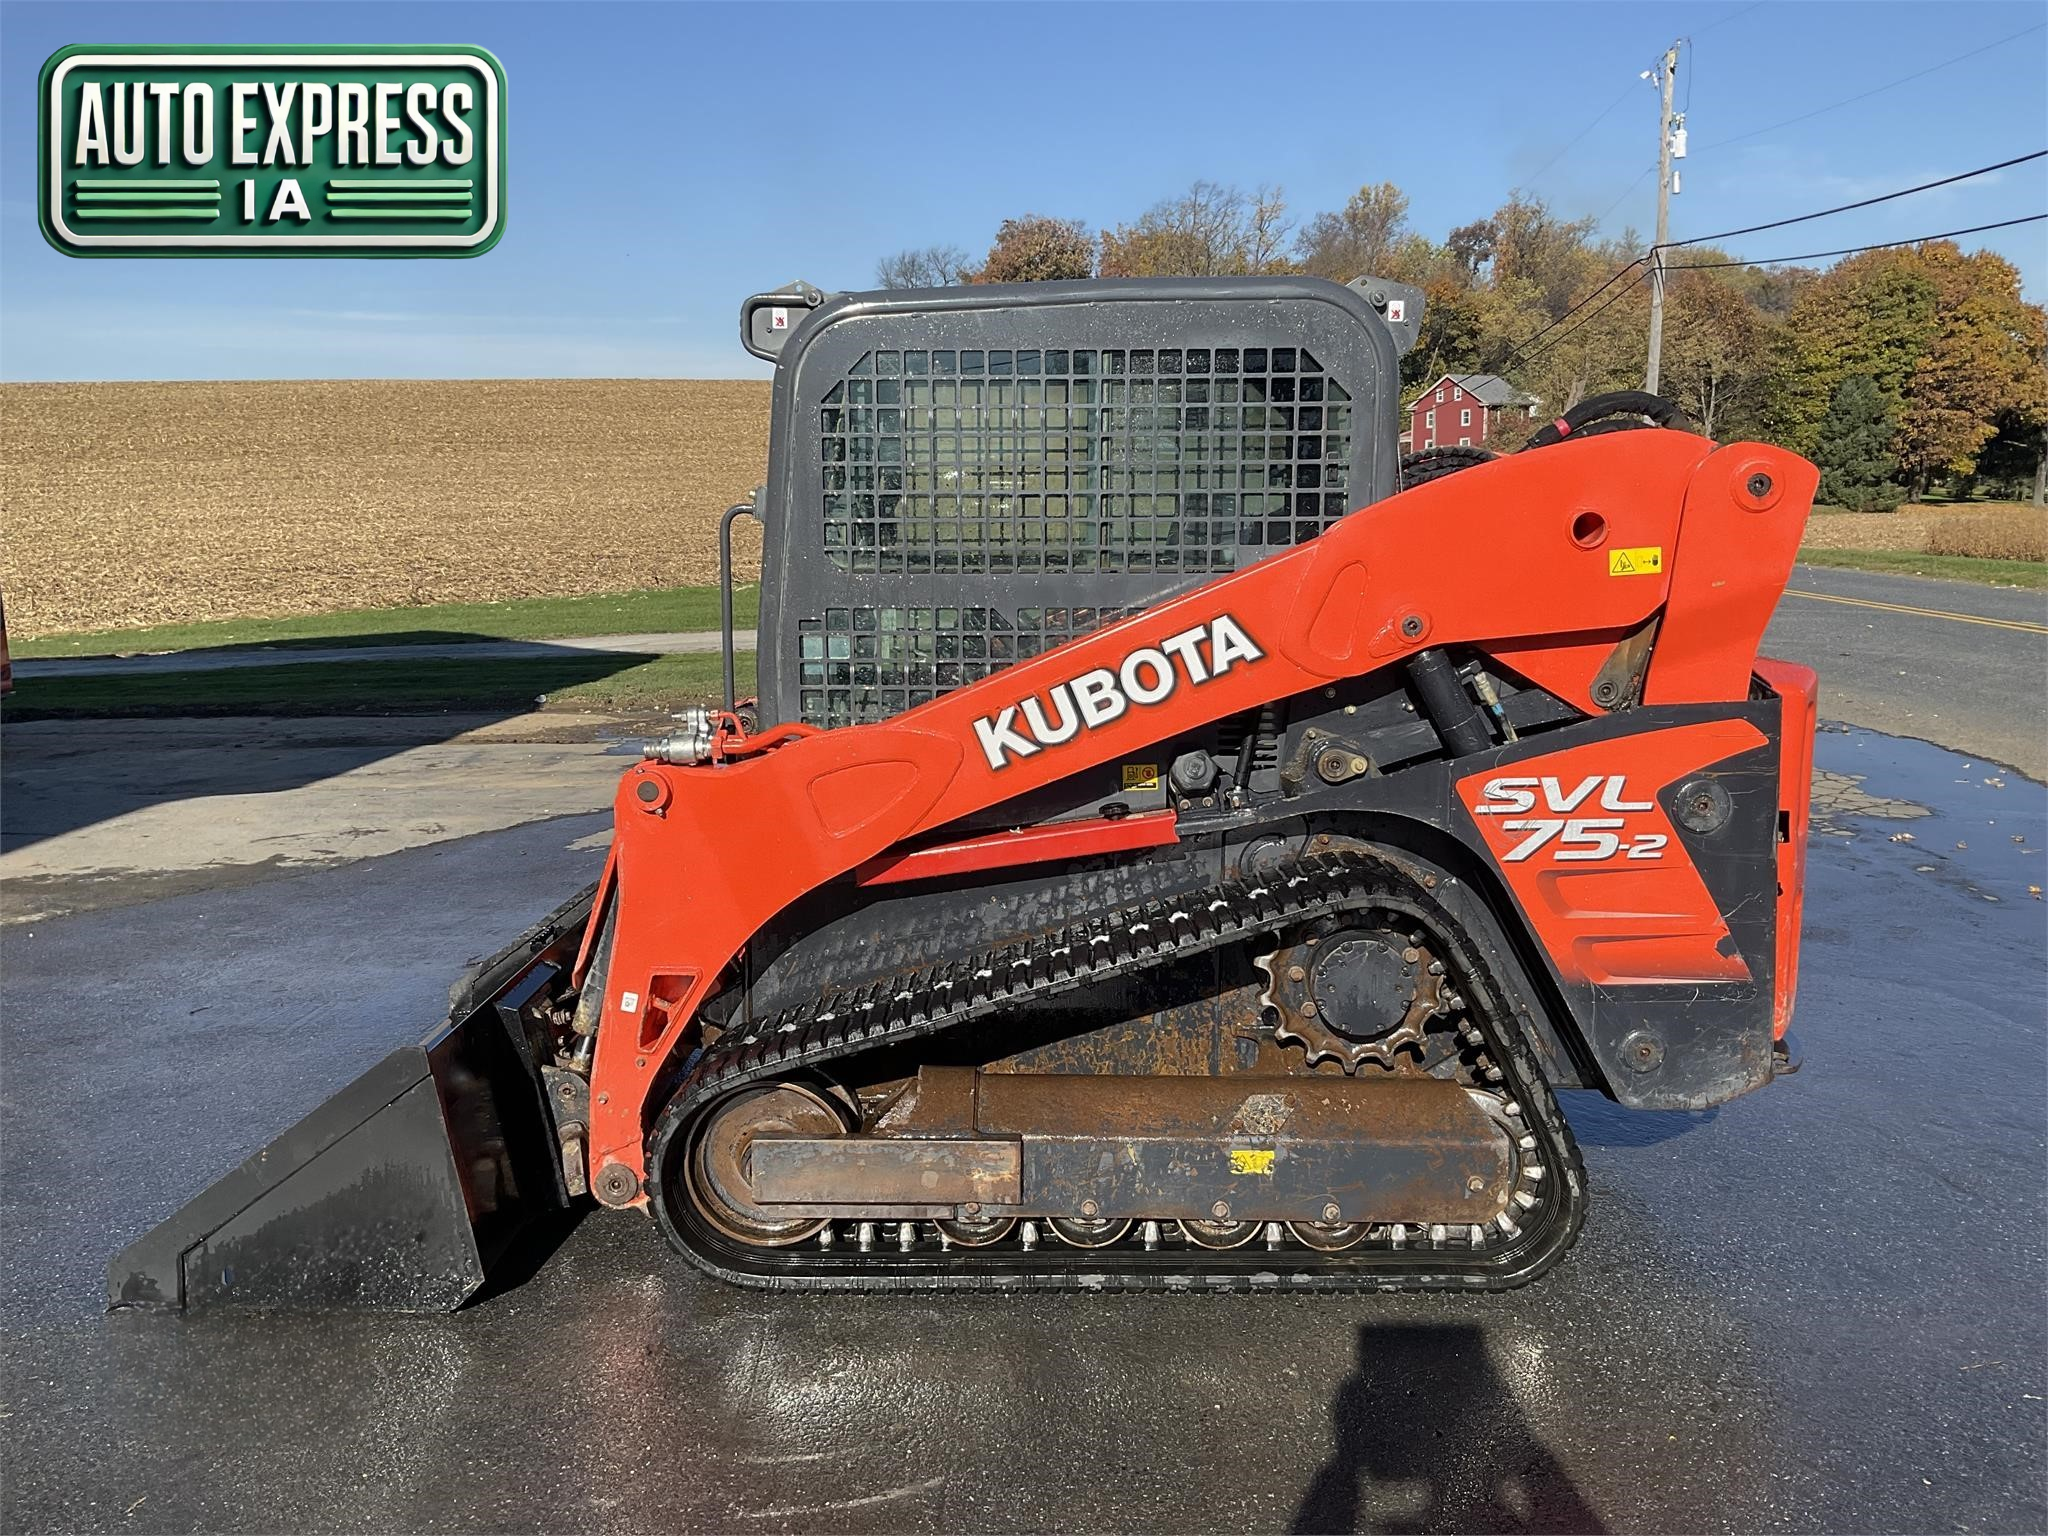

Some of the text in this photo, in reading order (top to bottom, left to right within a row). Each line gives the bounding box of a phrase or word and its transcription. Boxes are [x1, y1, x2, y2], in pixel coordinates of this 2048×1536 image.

[972, 614, 1264, 770] KUBOTA
[1474, 775, 1654, 815] SVL
[1501, 818, 1669, 862] 75-2
